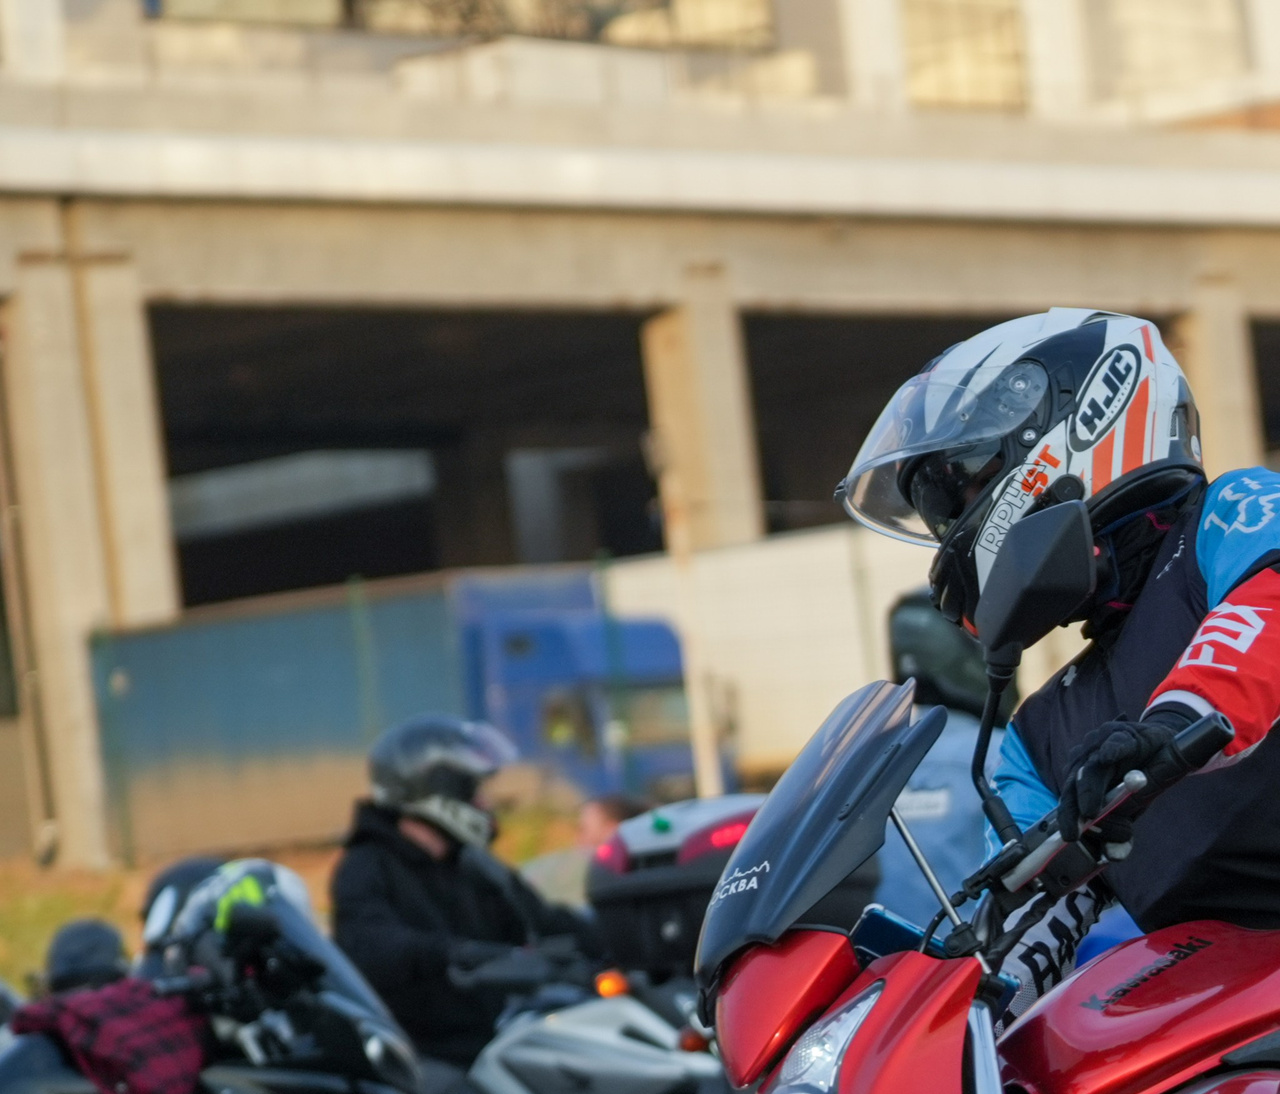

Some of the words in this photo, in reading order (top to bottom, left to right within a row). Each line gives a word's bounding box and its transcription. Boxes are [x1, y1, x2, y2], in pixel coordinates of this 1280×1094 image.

[1079, 350, 1133, 436] HJC
[710, 875, 758, 906] ОСКВА
[1081, 935, 1215, 1012] Kawasaki
